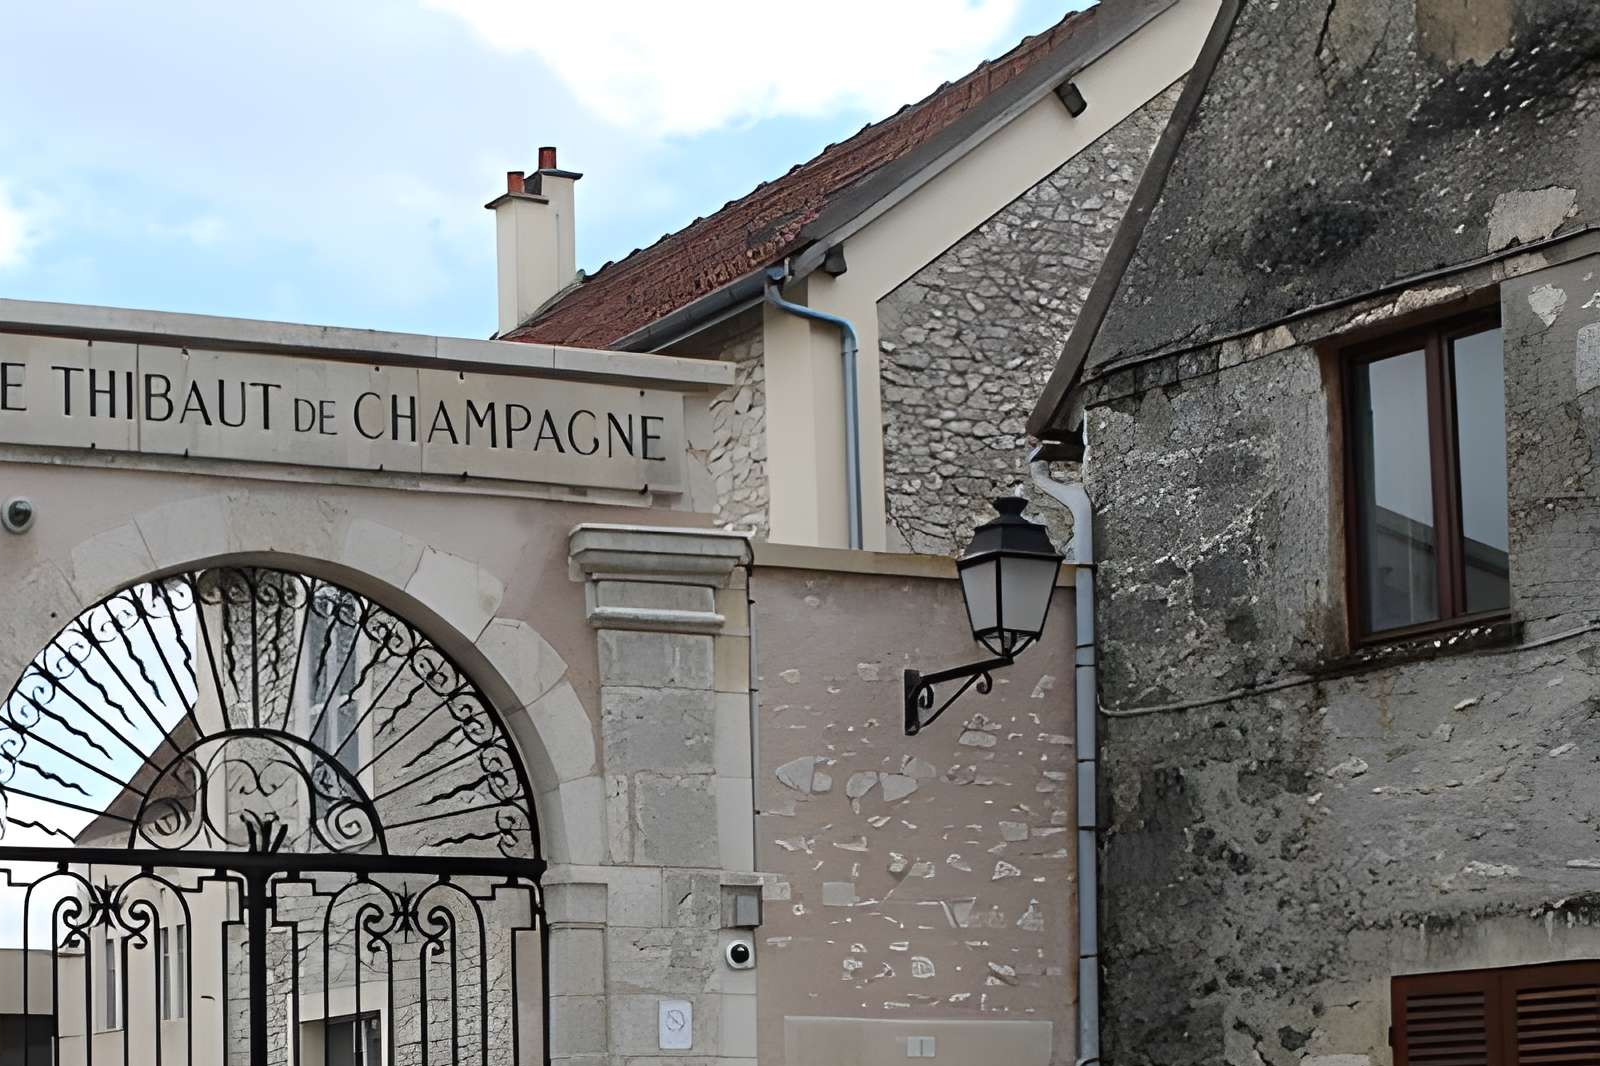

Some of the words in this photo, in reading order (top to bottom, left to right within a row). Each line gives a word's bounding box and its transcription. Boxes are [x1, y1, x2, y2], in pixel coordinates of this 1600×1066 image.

[50, 365, 282, 431] THIBAUT
[293, 397, 338, 436] DE
[353, 391, 666, 462] CHAMPAGNE
